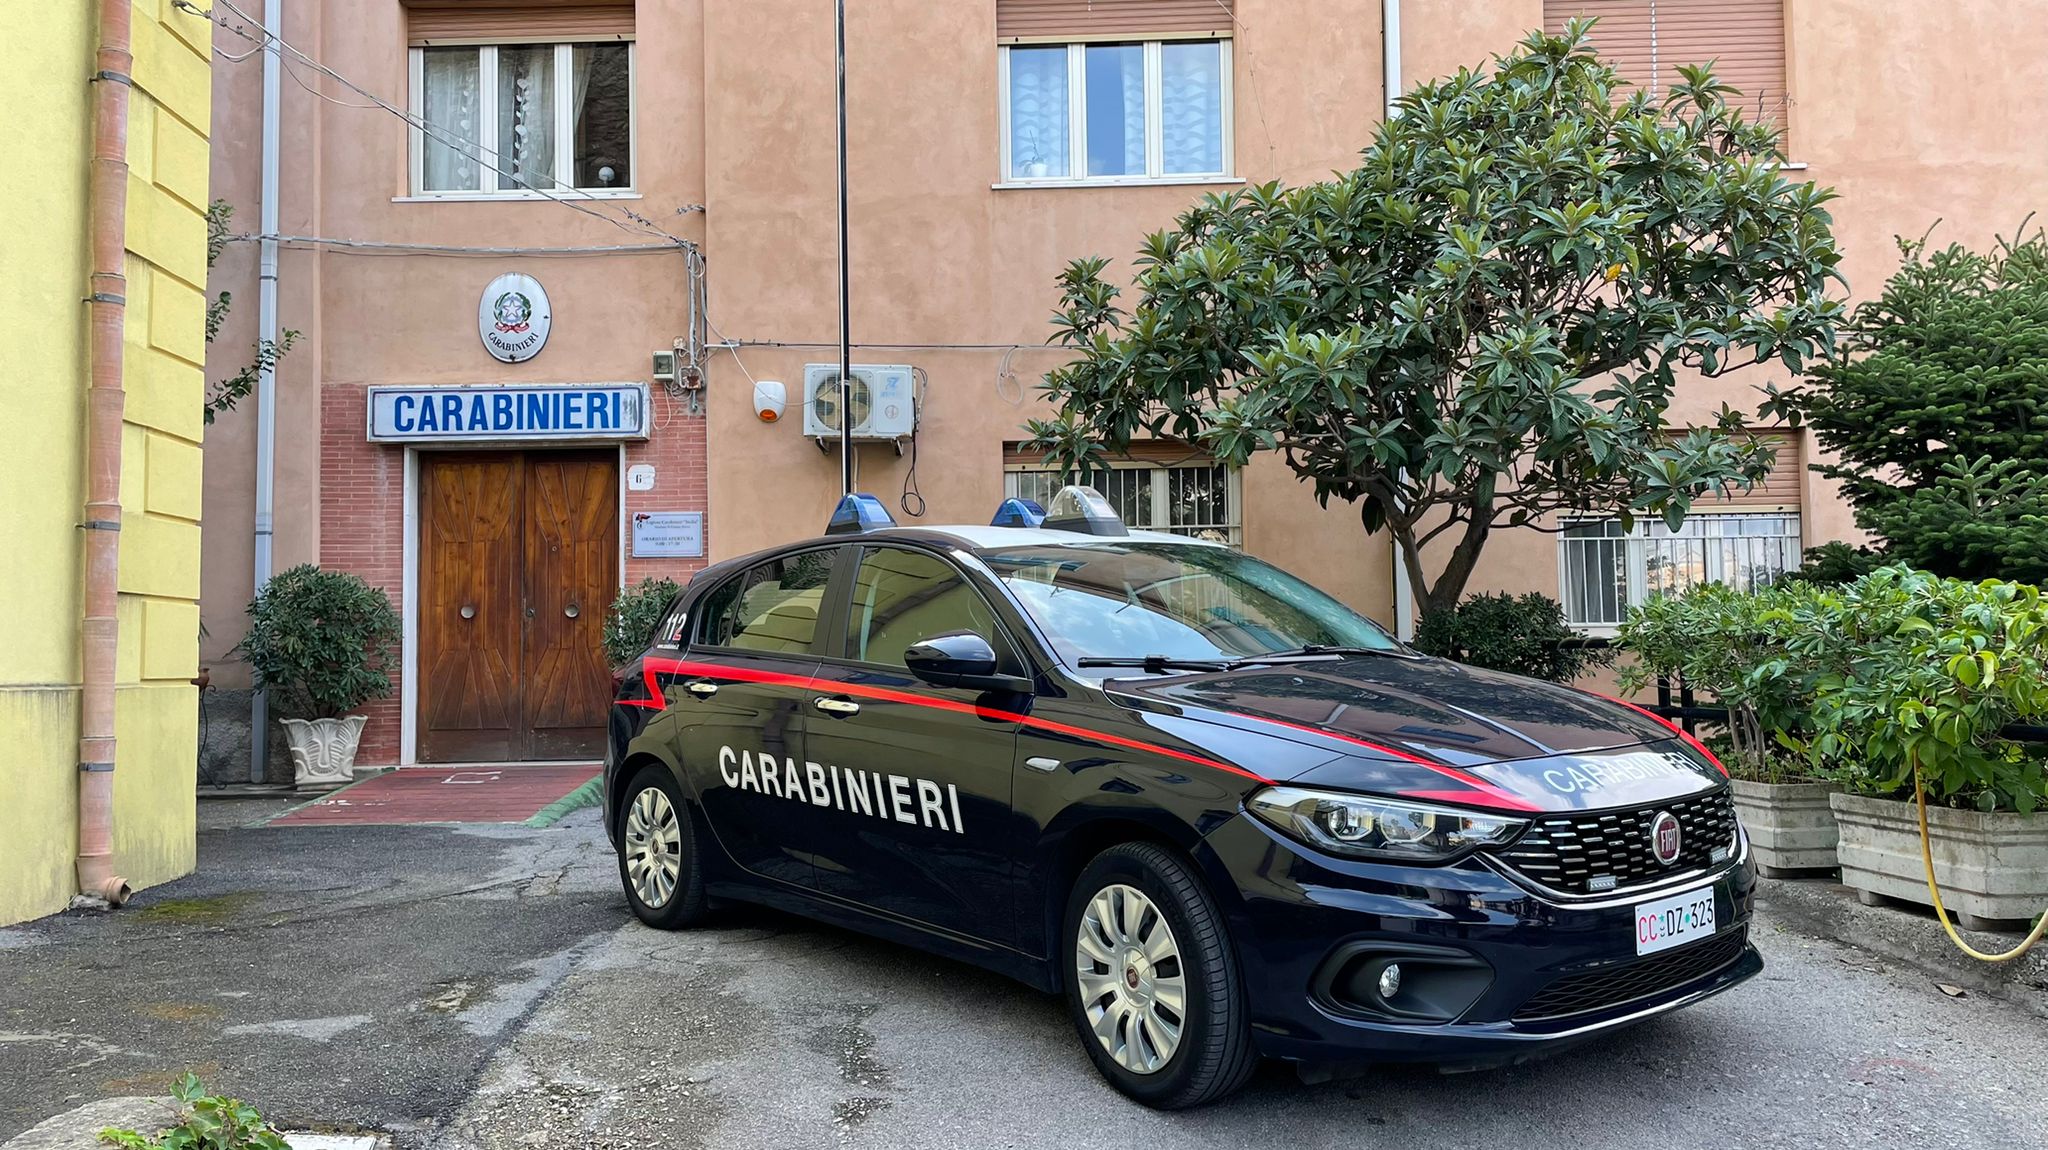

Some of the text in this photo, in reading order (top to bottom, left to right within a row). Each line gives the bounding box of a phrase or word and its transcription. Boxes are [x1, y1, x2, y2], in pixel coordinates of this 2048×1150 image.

[488, 331, 539, 352] CARABINIERI
[394, 392, 620, 432] CARABINIERI
[662, 613, 687, 641] 112
[1543, 751, 1704, 793] CARABINIERI
[719, 745, 965, 834] CARABINIERI
[1660, 828, 1676, 853] FIAT
